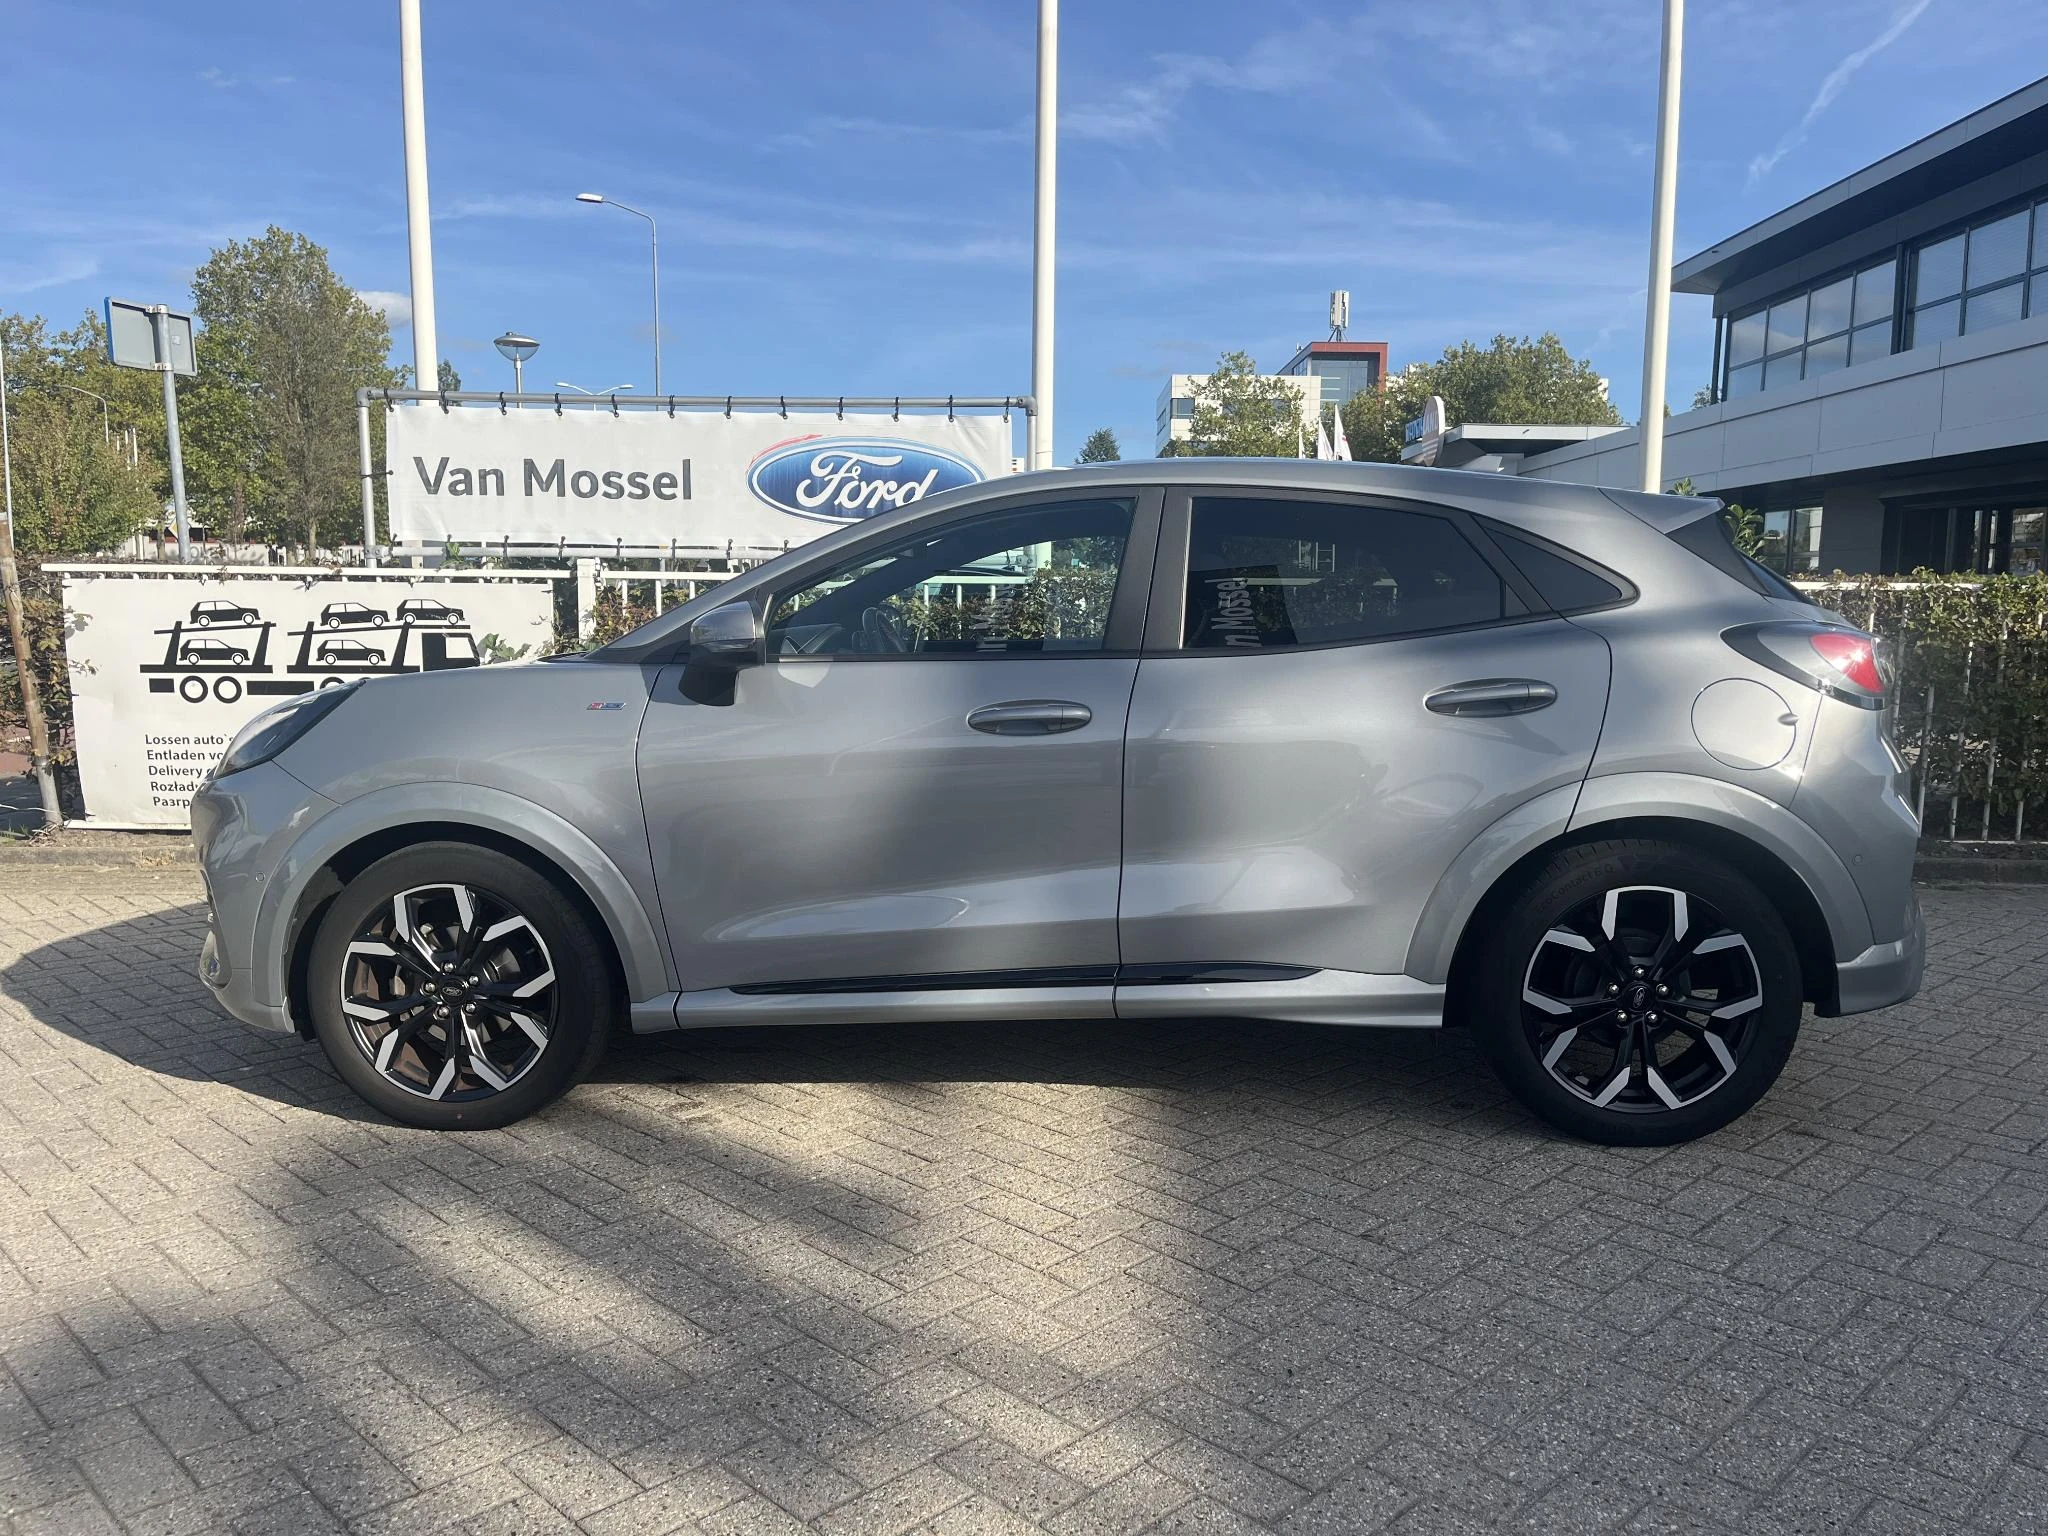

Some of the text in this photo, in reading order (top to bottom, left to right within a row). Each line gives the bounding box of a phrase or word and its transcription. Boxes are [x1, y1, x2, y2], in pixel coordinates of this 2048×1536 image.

[413, 456, 692, 500] Van Mossel
[796, 450, 937, 509] Ford
[145, 734, 190, 745] Lossen
[147, 749, 206, 761] Entladen
[149, 765, 203, 778] Delivery
